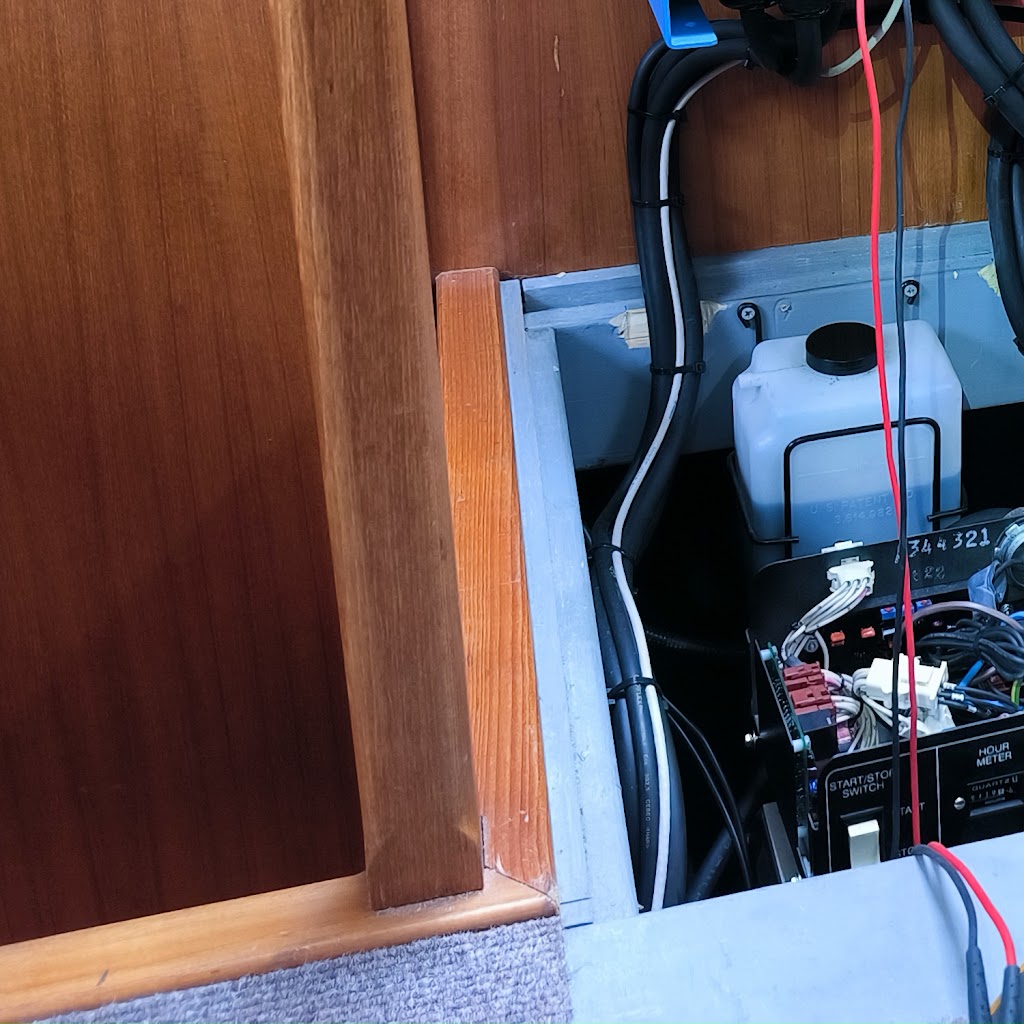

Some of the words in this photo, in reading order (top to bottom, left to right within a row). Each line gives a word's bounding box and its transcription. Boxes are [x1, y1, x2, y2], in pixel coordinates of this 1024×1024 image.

[840, 494, 888, 510] PATENT
[978, 742, 1010, 757] HOUR
[976, 750, 1013, 768] METER
[842, 782, 885, 799] SWITCH
[900, 802, 926, 816] TAT
